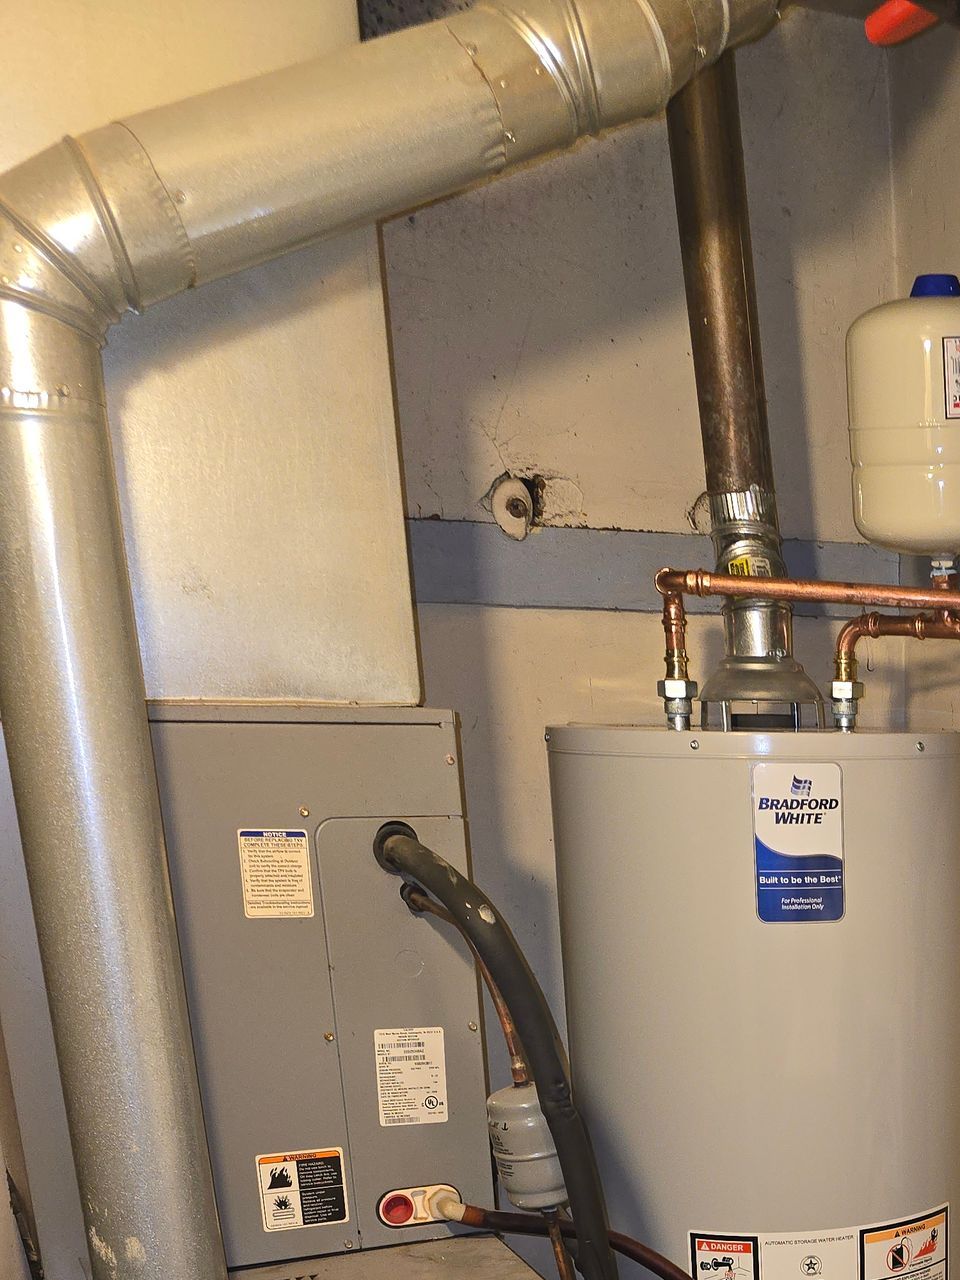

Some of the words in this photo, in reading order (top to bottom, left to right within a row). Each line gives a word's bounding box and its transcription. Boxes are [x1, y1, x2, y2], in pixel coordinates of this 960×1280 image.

[758, 797, 839, 810] BRADFORD
[774, 811, 823, 825] WHITE
[759, 875, 779, 884] Built
[780, 875, 789, 884] to
[791, 875, 802, 884] be
[803, 875, 818, 884] the
[819, 875, 839, 884] Best
[790, 896, 823, 904] Professional
[812, 903, 825, 911] Only
[289, 1153, 317, 1161] WARNING
[901, 1224, 926, 1236] WARNING
[835, 1234, 854, 1242] HEATER
[710, 1243, 744, 1252] DANGER
[724, 1270, 737, 1279] HOT
